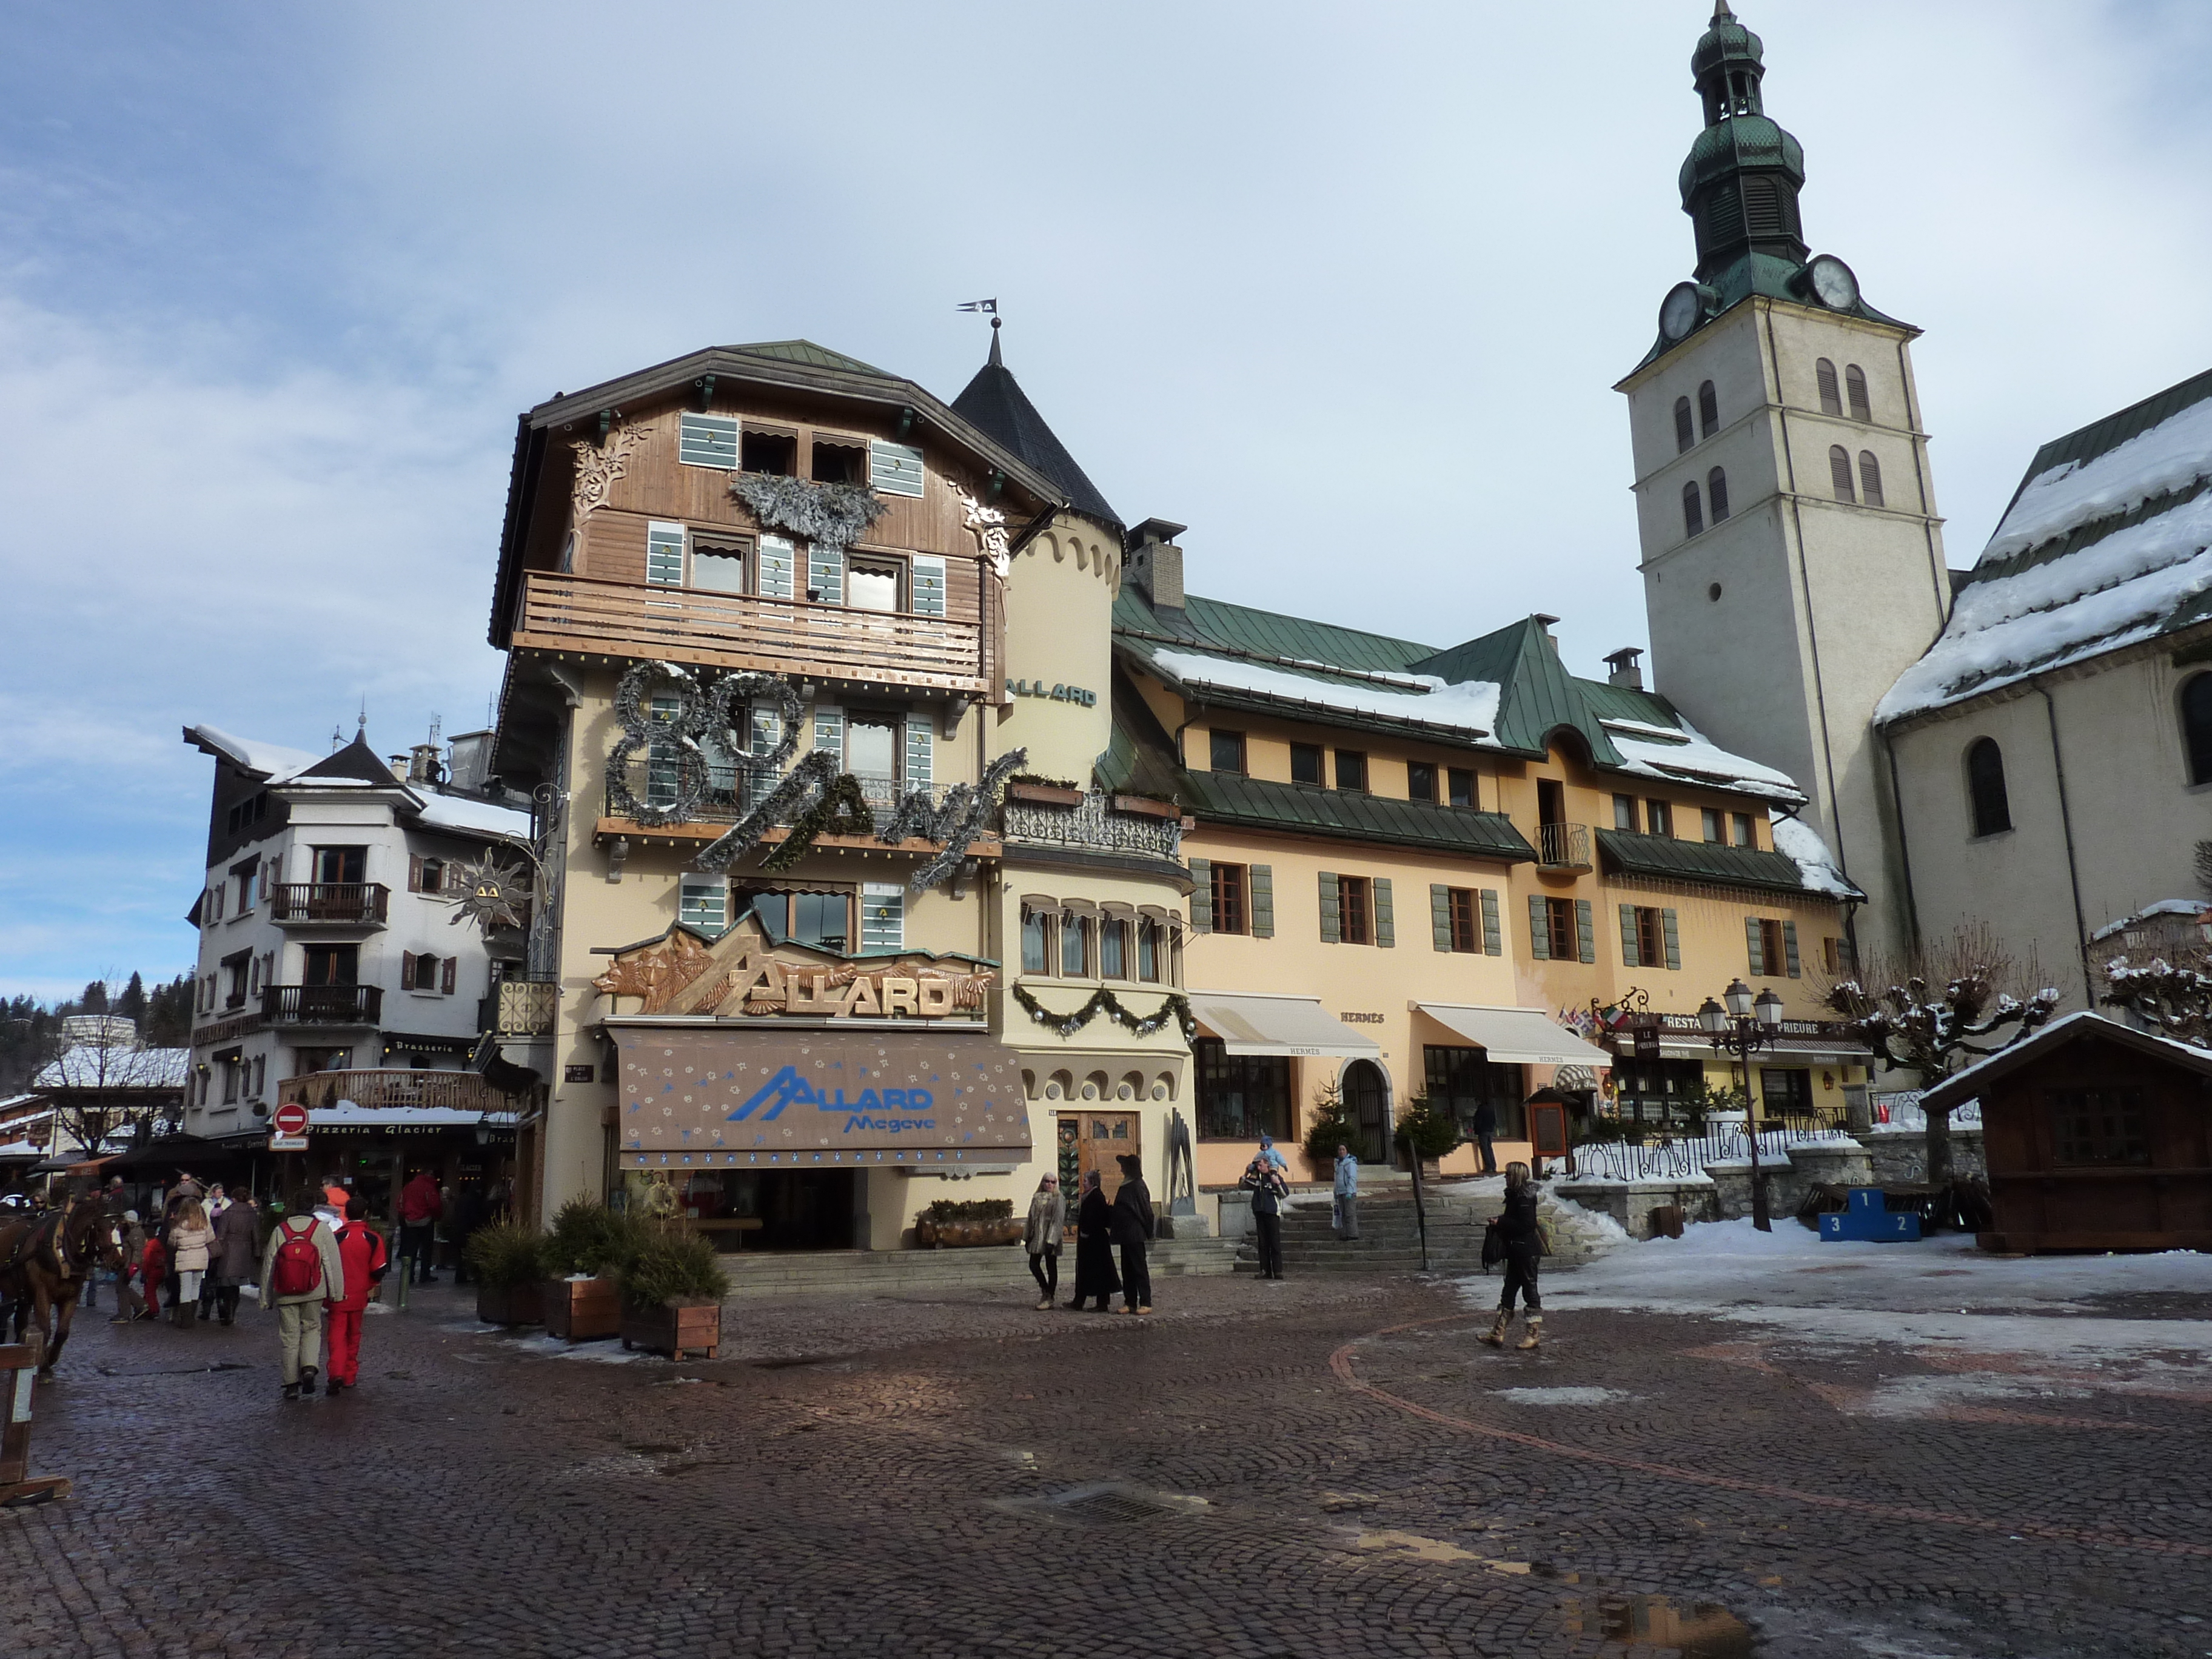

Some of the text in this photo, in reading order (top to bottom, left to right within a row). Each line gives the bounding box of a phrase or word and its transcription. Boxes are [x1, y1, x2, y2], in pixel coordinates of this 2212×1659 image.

[1667, 1016, 1737, 1030] RESTANT
[396, 1041, 453, 1053] Brasserie
[306, 1125, 442, 1134] Pizzeria Glacier
[1862, 1193, 1868, 1206] 1
[1831, 1216, 1906, 1232] 3 2
